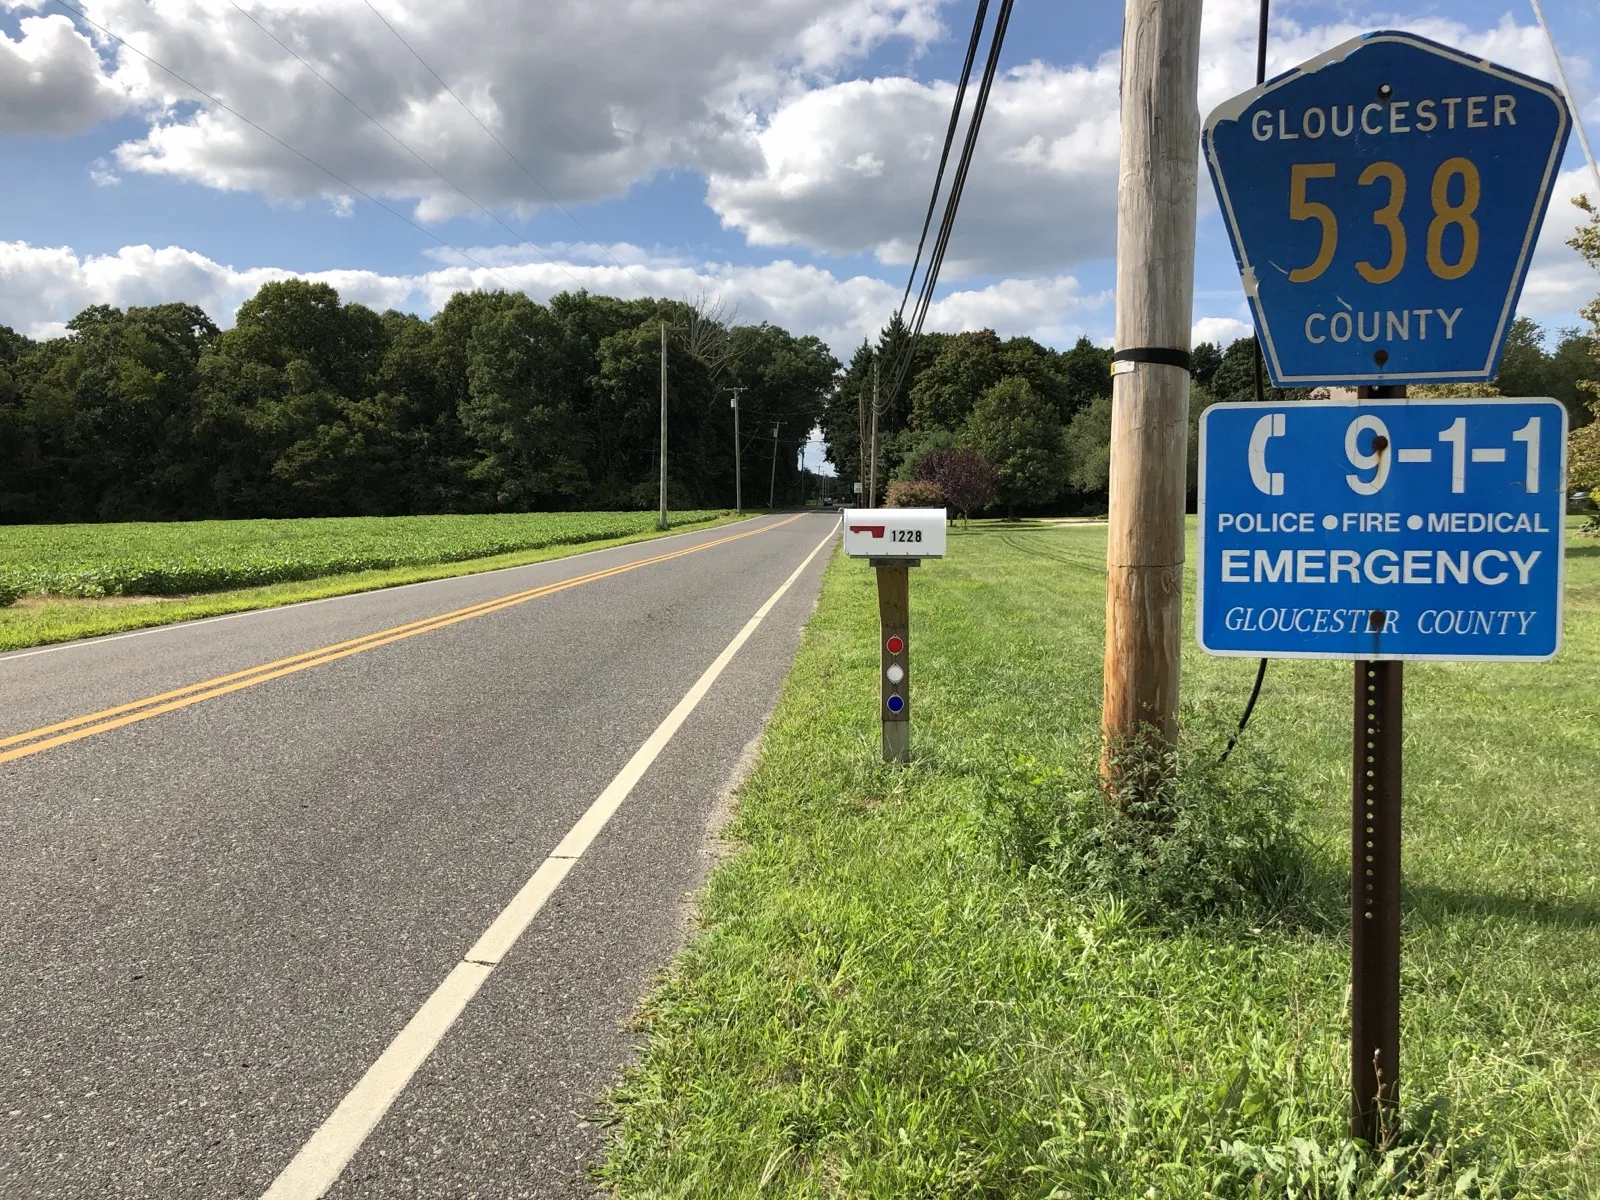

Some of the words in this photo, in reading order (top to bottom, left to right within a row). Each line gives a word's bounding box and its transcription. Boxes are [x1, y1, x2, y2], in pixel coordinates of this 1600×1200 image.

[1251, 94, 1518, 142] GLOUCESTER
[1288, 156, 1481, 284] 538
[1305, 307, 1463, 344] COUNTY
[1344, 414, 1541, 496] 9-1-1
[891, 530, 922, 543] 1228
[1218, 512, 1315, 533] POLICE
[1342, 511, 1400, 533] FIRE
[1427, 511, 1549, 534] MEDICAL
[1221, 549, 1542, 585] EMERGENCY
[1225, 606, 1399, 635] GLOUCESTER
[1417, 610, 1537, 636] COUNTY
